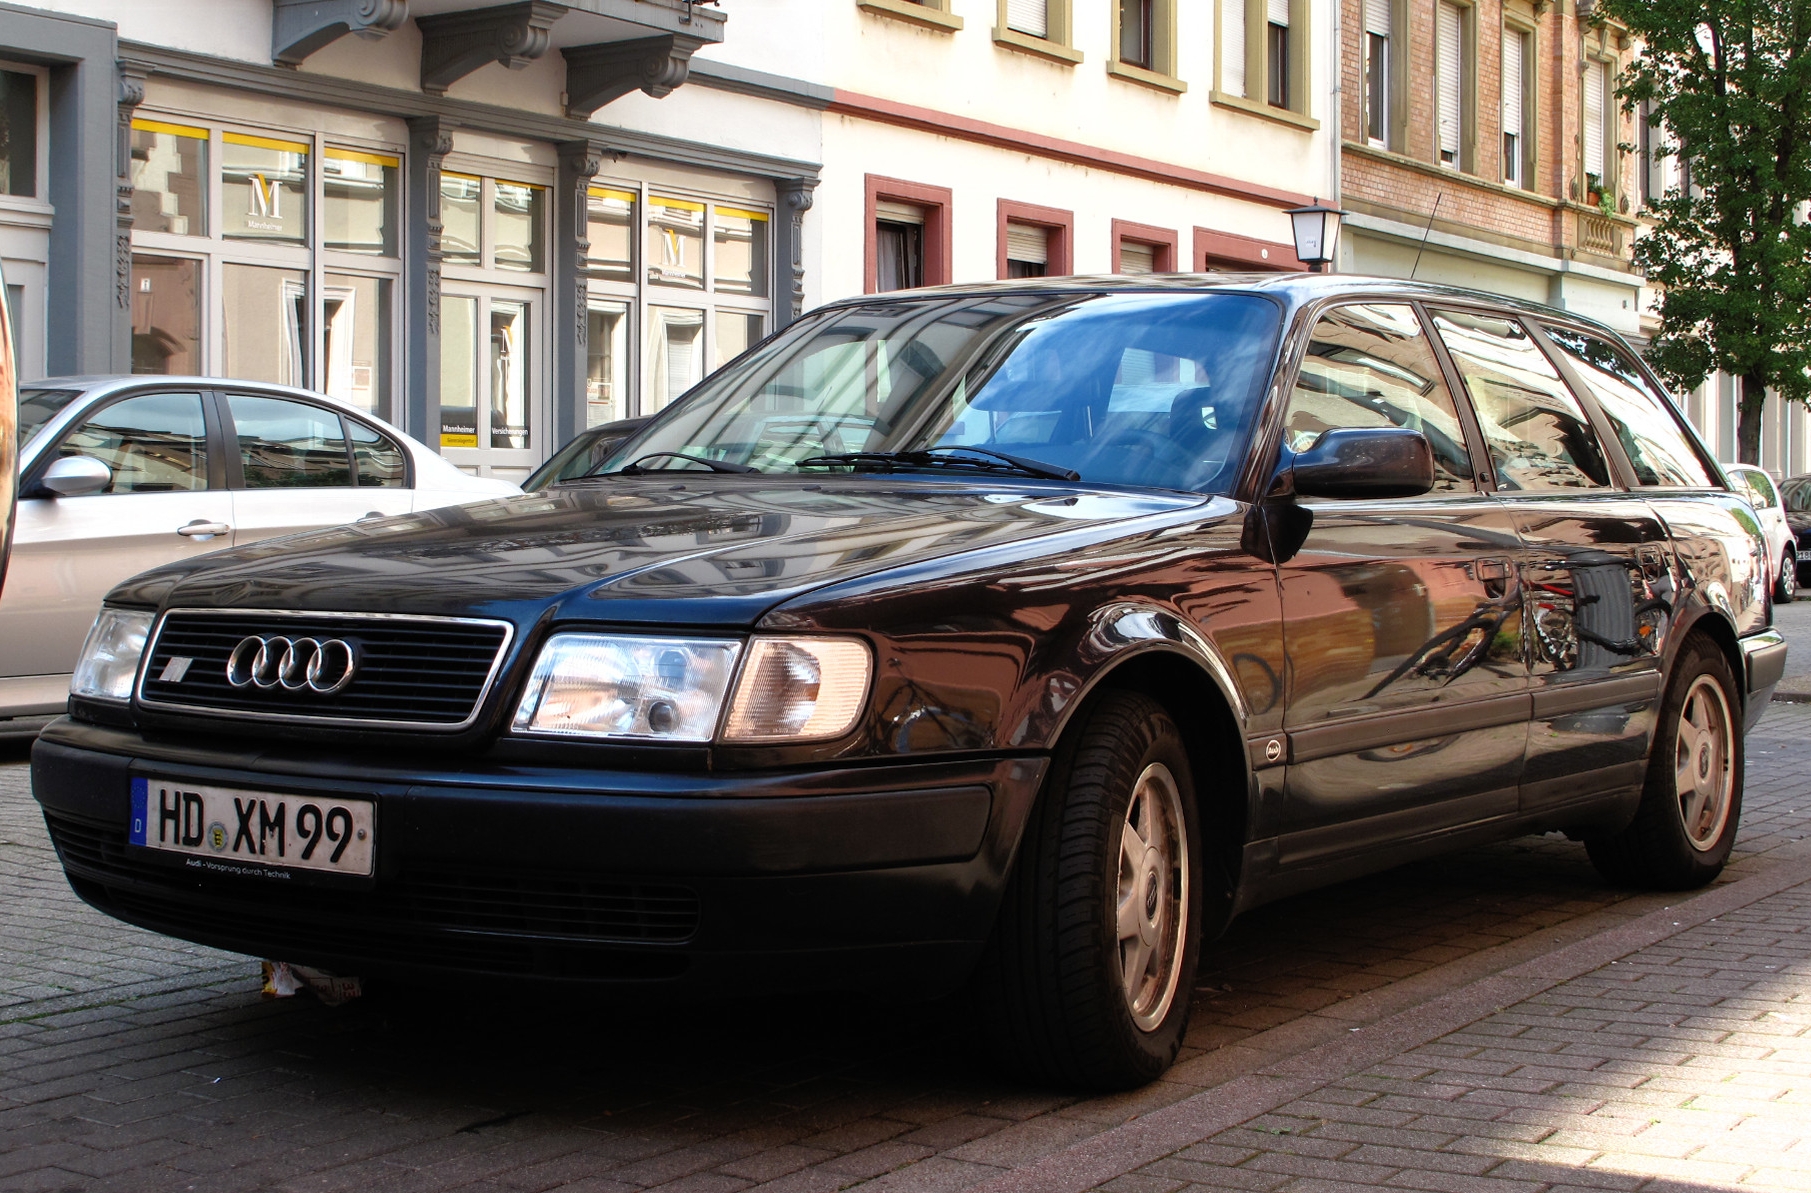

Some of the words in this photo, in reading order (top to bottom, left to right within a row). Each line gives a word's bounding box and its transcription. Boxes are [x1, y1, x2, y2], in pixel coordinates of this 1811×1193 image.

[442, 424, 476, 434] Mannheimer
[491, 426, 529, 437] Versicherungen
[134, 818, 142, 834] D
[159, 788, 205, 847] HD
[232, 796, 286, 858] XM
[296, 803, 354, 863] 99
[186, 858, 202, 867] Audi
[206, 862, 241, 875] Vorsprung
[242, 867, 262, 876] durch
[263, 869, 291, 879] Technik
